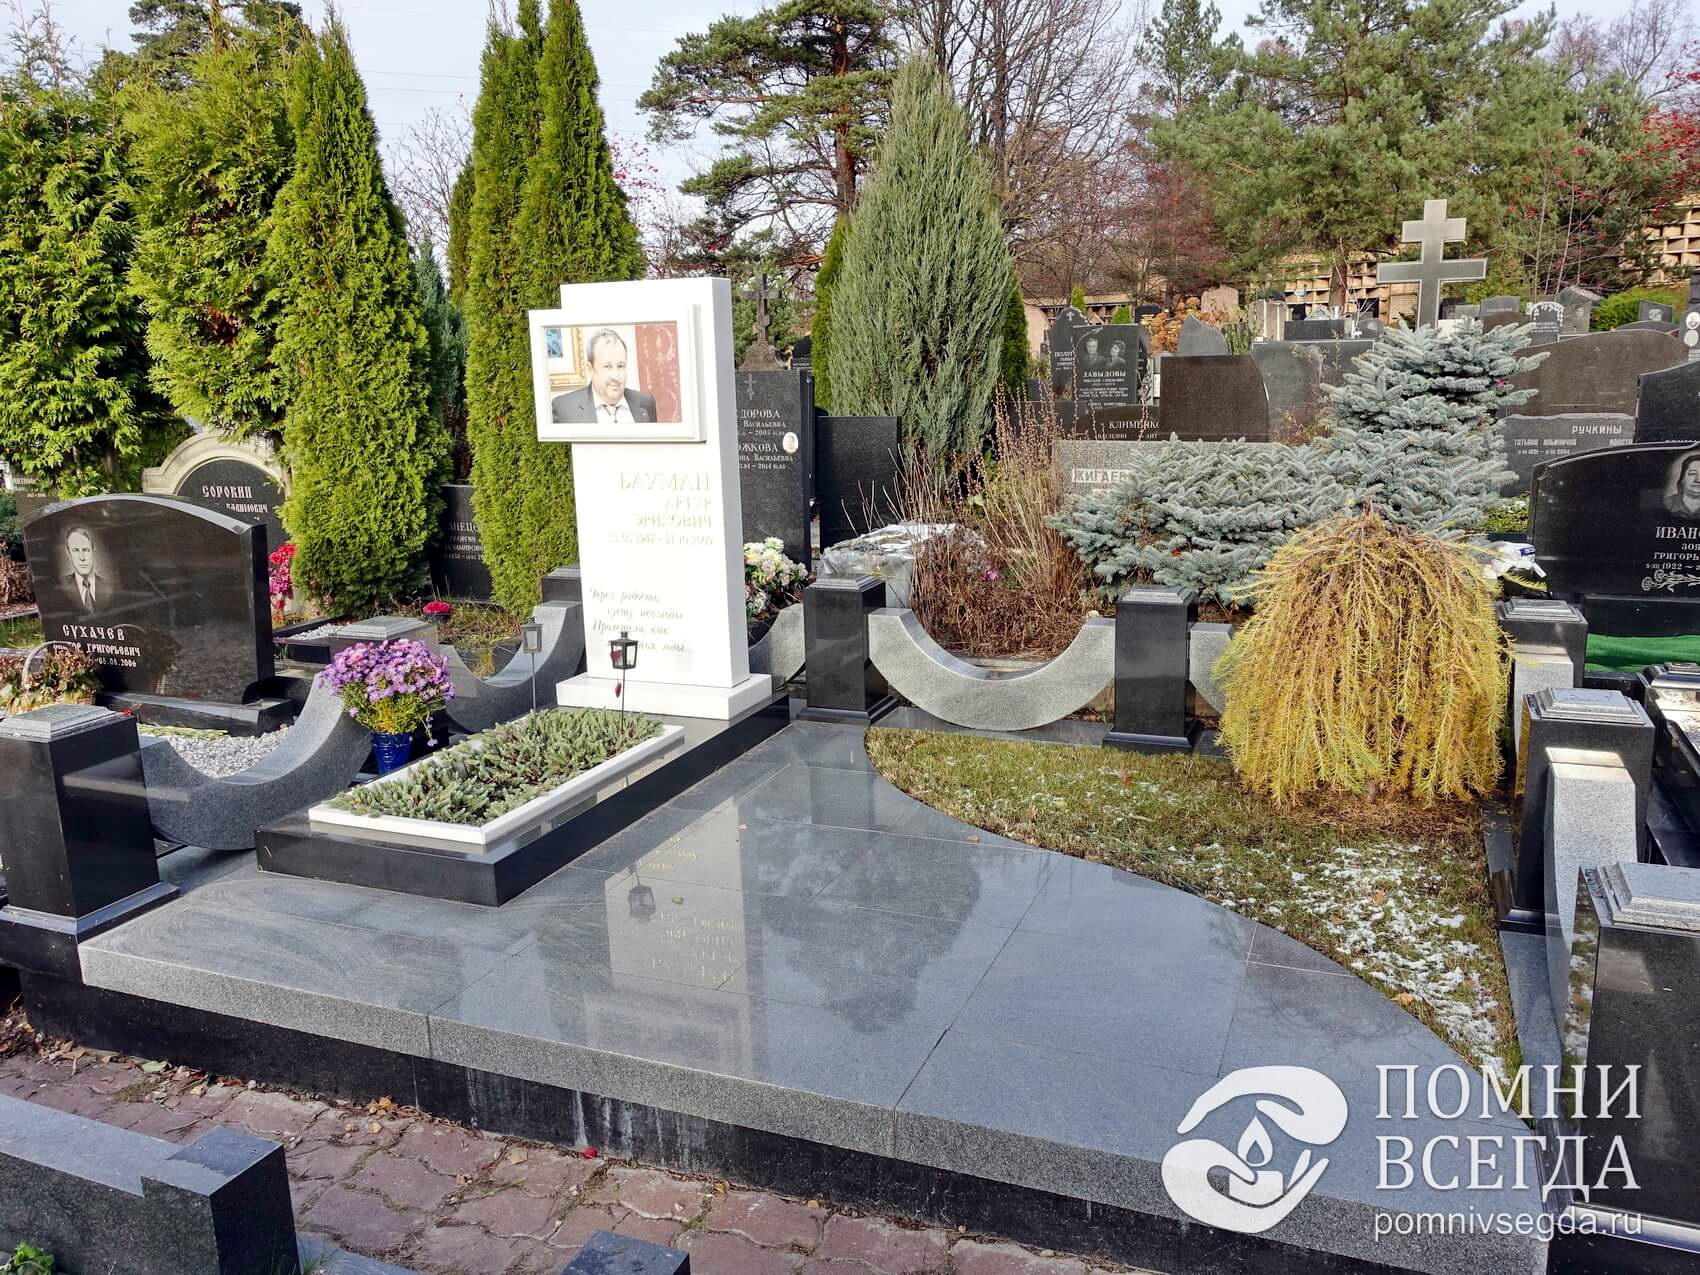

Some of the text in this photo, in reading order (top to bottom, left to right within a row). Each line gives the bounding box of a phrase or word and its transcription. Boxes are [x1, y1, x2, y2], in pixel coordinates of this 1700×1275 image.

[736, 409, 780, 419] ДОРОВА
[1571, 425, 1622, 434] РУЧКИНЫ
[619, 472, 711, 491] БАУМАН
[202, 485, 253, 498] СОРОКИН
[1655, 526, 1700, 539] ИВАН
[62, 624, 125, 641] СУХАЧЕВ
[86, 643, 141, 657] ГРИГОРЬЕВИЧ
